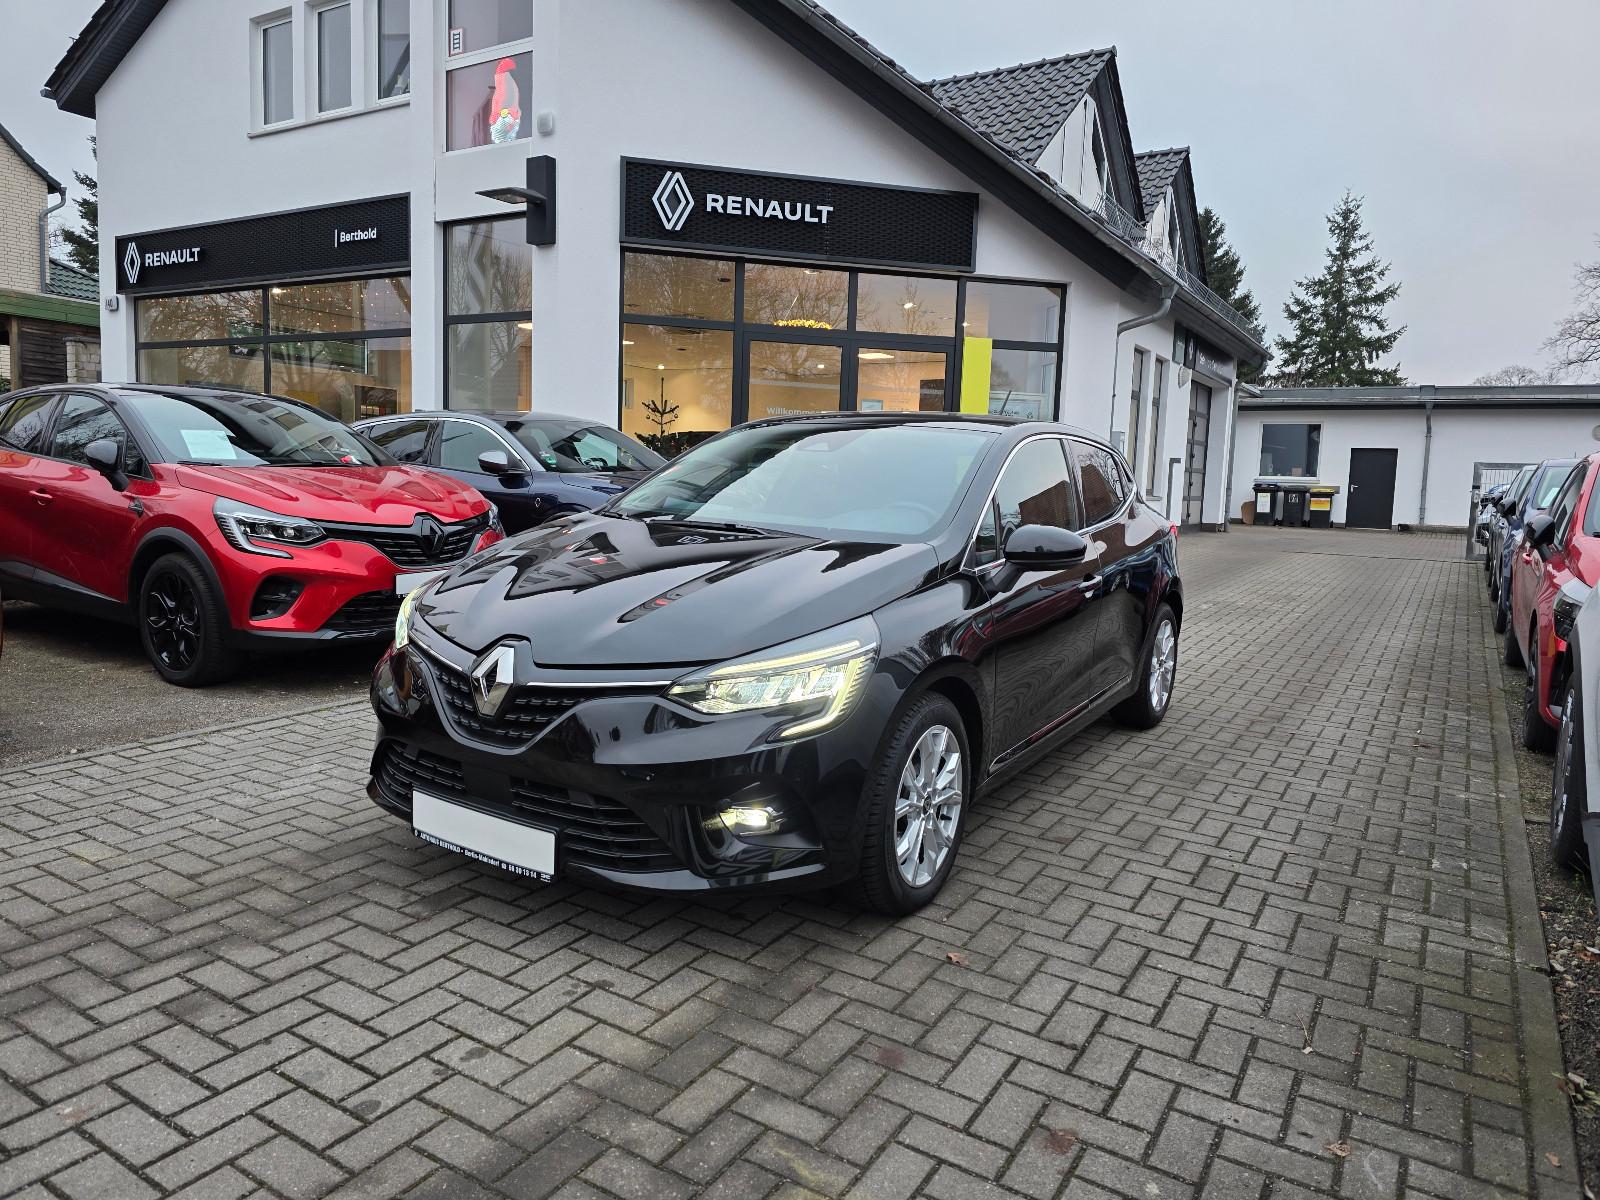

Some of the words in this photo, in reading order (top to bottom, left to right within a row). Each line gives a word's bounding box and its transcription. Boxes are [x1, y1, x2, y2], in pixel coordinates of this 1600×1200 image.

[706, 193, 834, 224] RENAULT
[339, 227, 377, 243] Berthold
[145, 247, 201, 267] RENAULT
